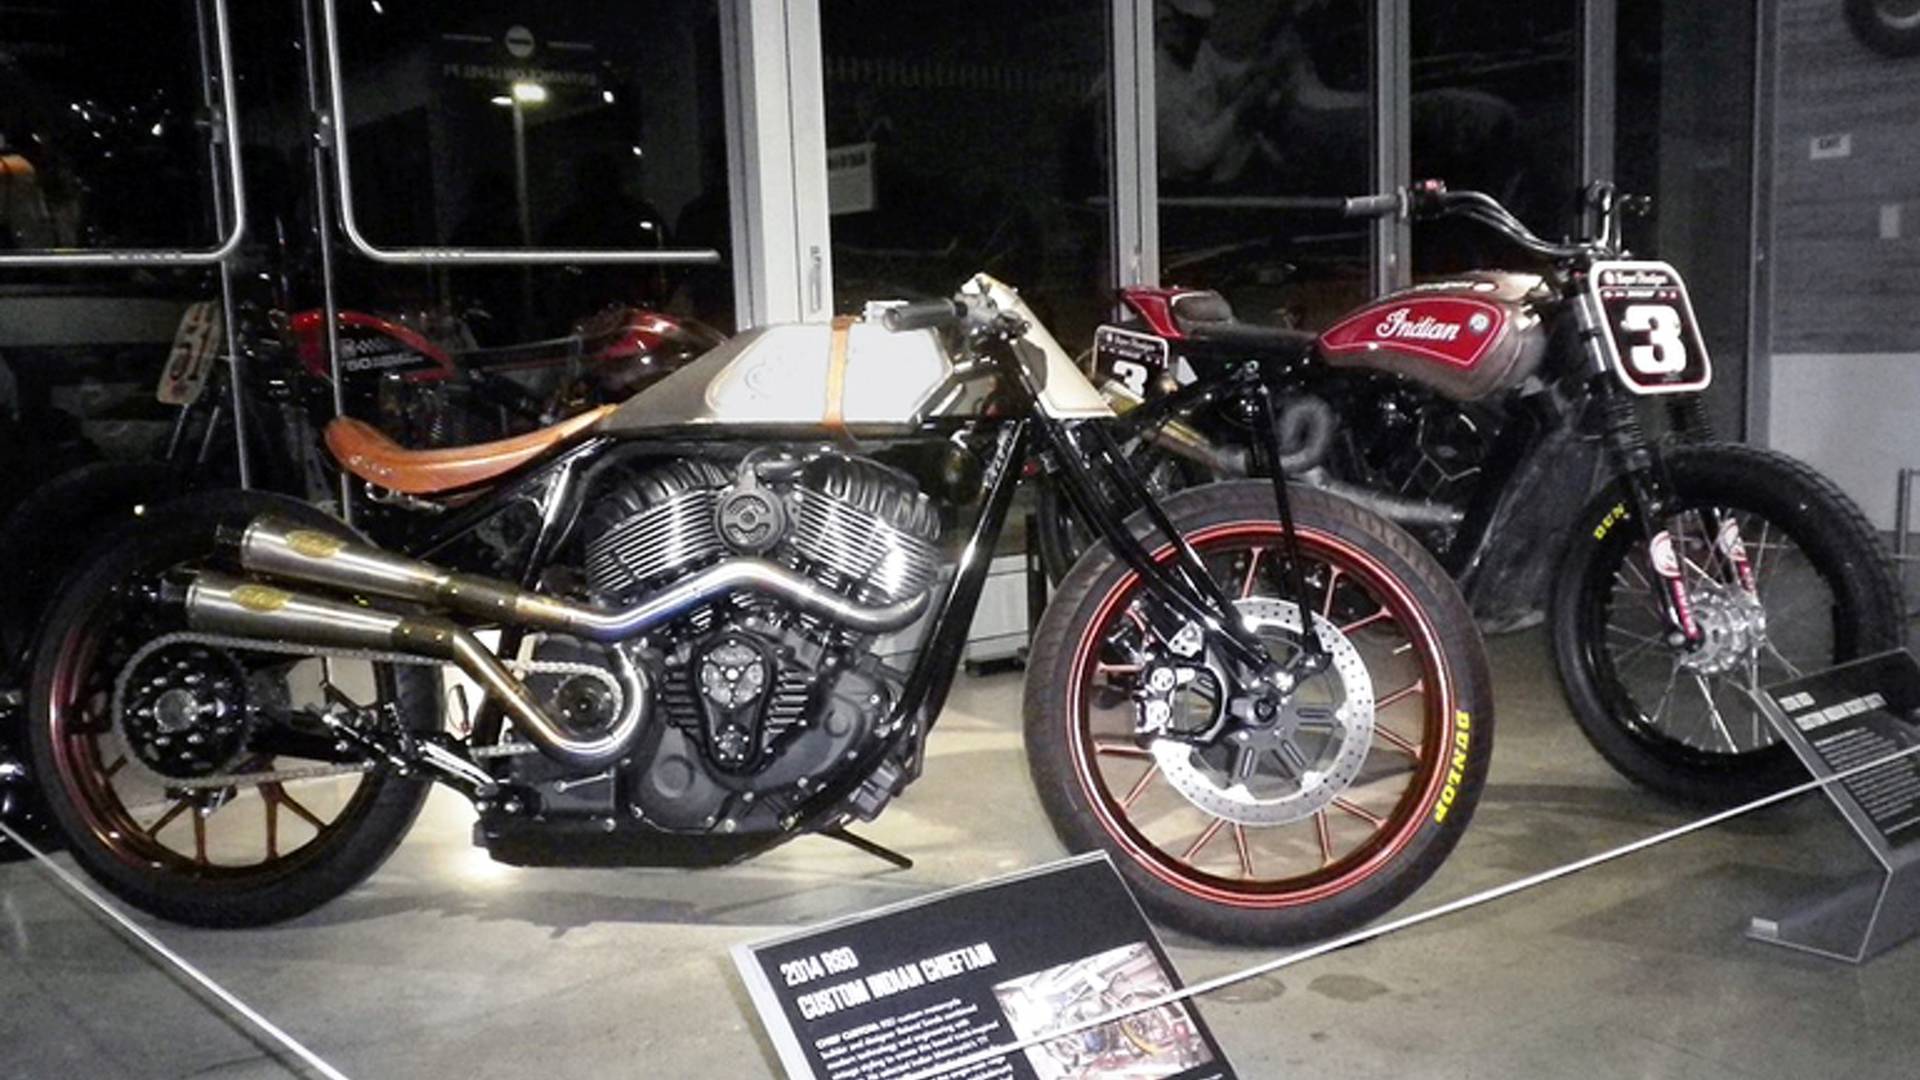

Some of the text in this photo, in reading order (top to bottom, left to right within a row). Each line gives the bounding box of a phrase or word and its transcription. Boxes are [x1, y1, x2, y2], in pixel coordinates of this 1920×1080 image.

[1376, 307, 1460, 340] Indian
[1620, 305, 1687, 374] 3
[1434, 709, 1469, 822] DUNLOP
[780, 957, 825, 986] 2014
[797, 979, 871, 1019] CUSTOM
[866, 964, 925, 999] INDIAN
[919, 942, 997, 982] CHIEFTAIN
